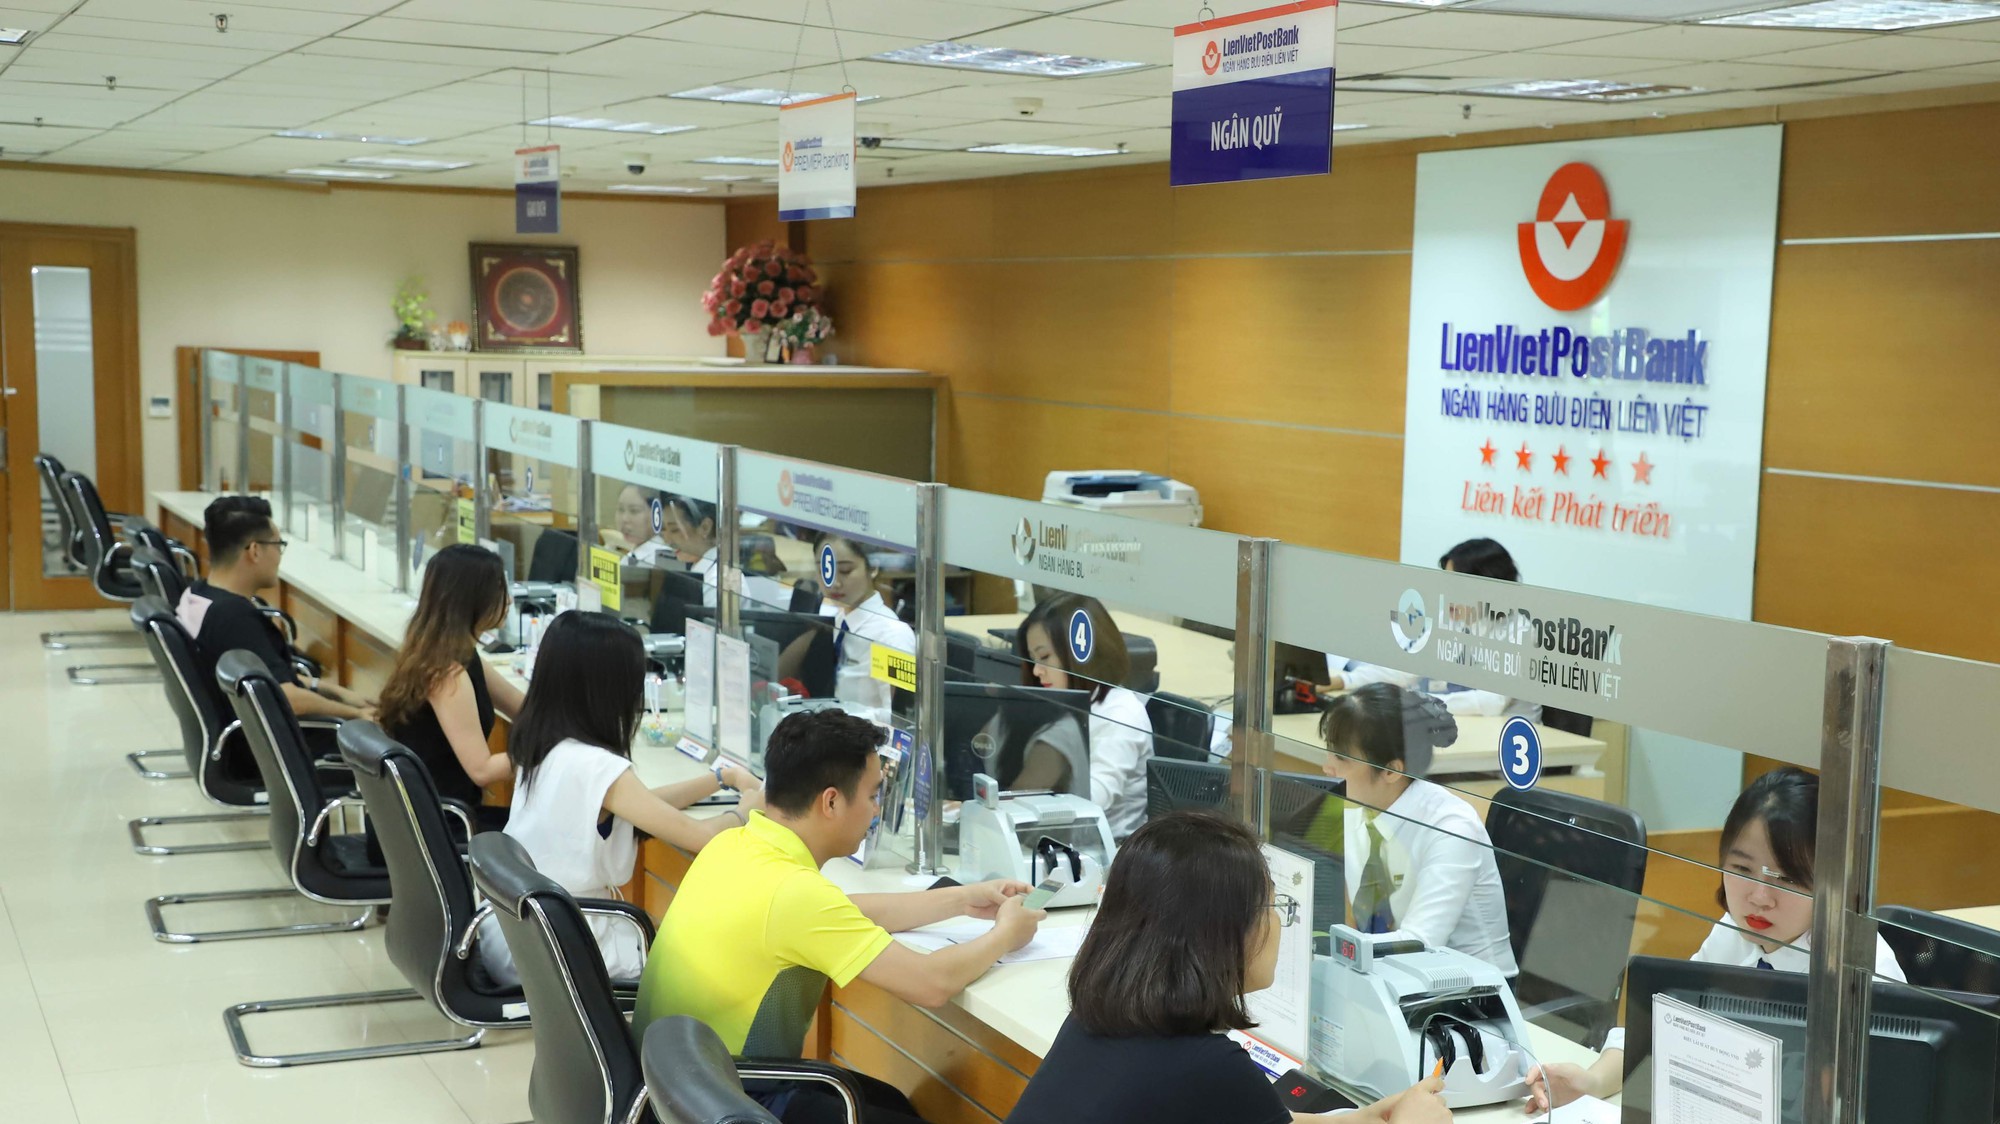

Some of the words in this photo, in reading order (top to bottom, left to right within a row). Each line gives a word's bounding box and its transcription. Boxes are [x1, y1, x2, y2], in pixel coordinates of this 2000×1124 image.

[1223, 25, 1299, 57] LienVietPostBank
[1211, 113, 1250, 151] NGÂN
[1252, 106, 1283, 151] QUỸ
[1440, 322, 1709, 385] LienVietPostBank
[1441, 383, 1480, 419] NGÂN
[1486, 386, 1528, 422] HÀNG
[1571, 391, 1611, 435] ĐIỆN
[1617, 393, 1658, 435] LIÊN
[1663, 397, 1709, 442] VIỆT
[653, 508, 660, 526] 6
[1461, 480, 1505, 515] Liên
[1511, 484, 1545, 521] kết
[1551, 493, 1606, 529] Phát
[1611, 501, 1672, 539] triển
[825, 555, 832, 579] 5
[1039, 552, 1056, 573] NGÂN
[1057, 554, 1075, 578] HÀNG
[1075, 622, 1087, 652] 4
[1438, 594, 1624, 666] LienVietPostBank
[1437, 637, 1466, 666] NGÂN
[1529, 655, 1558, 688] ĐIỆN
[1562, 661, 1589, 693] LIÊN
[1592, 668, 1622, 702] VIỆT
[1512, 735, 1530, 775] 3
